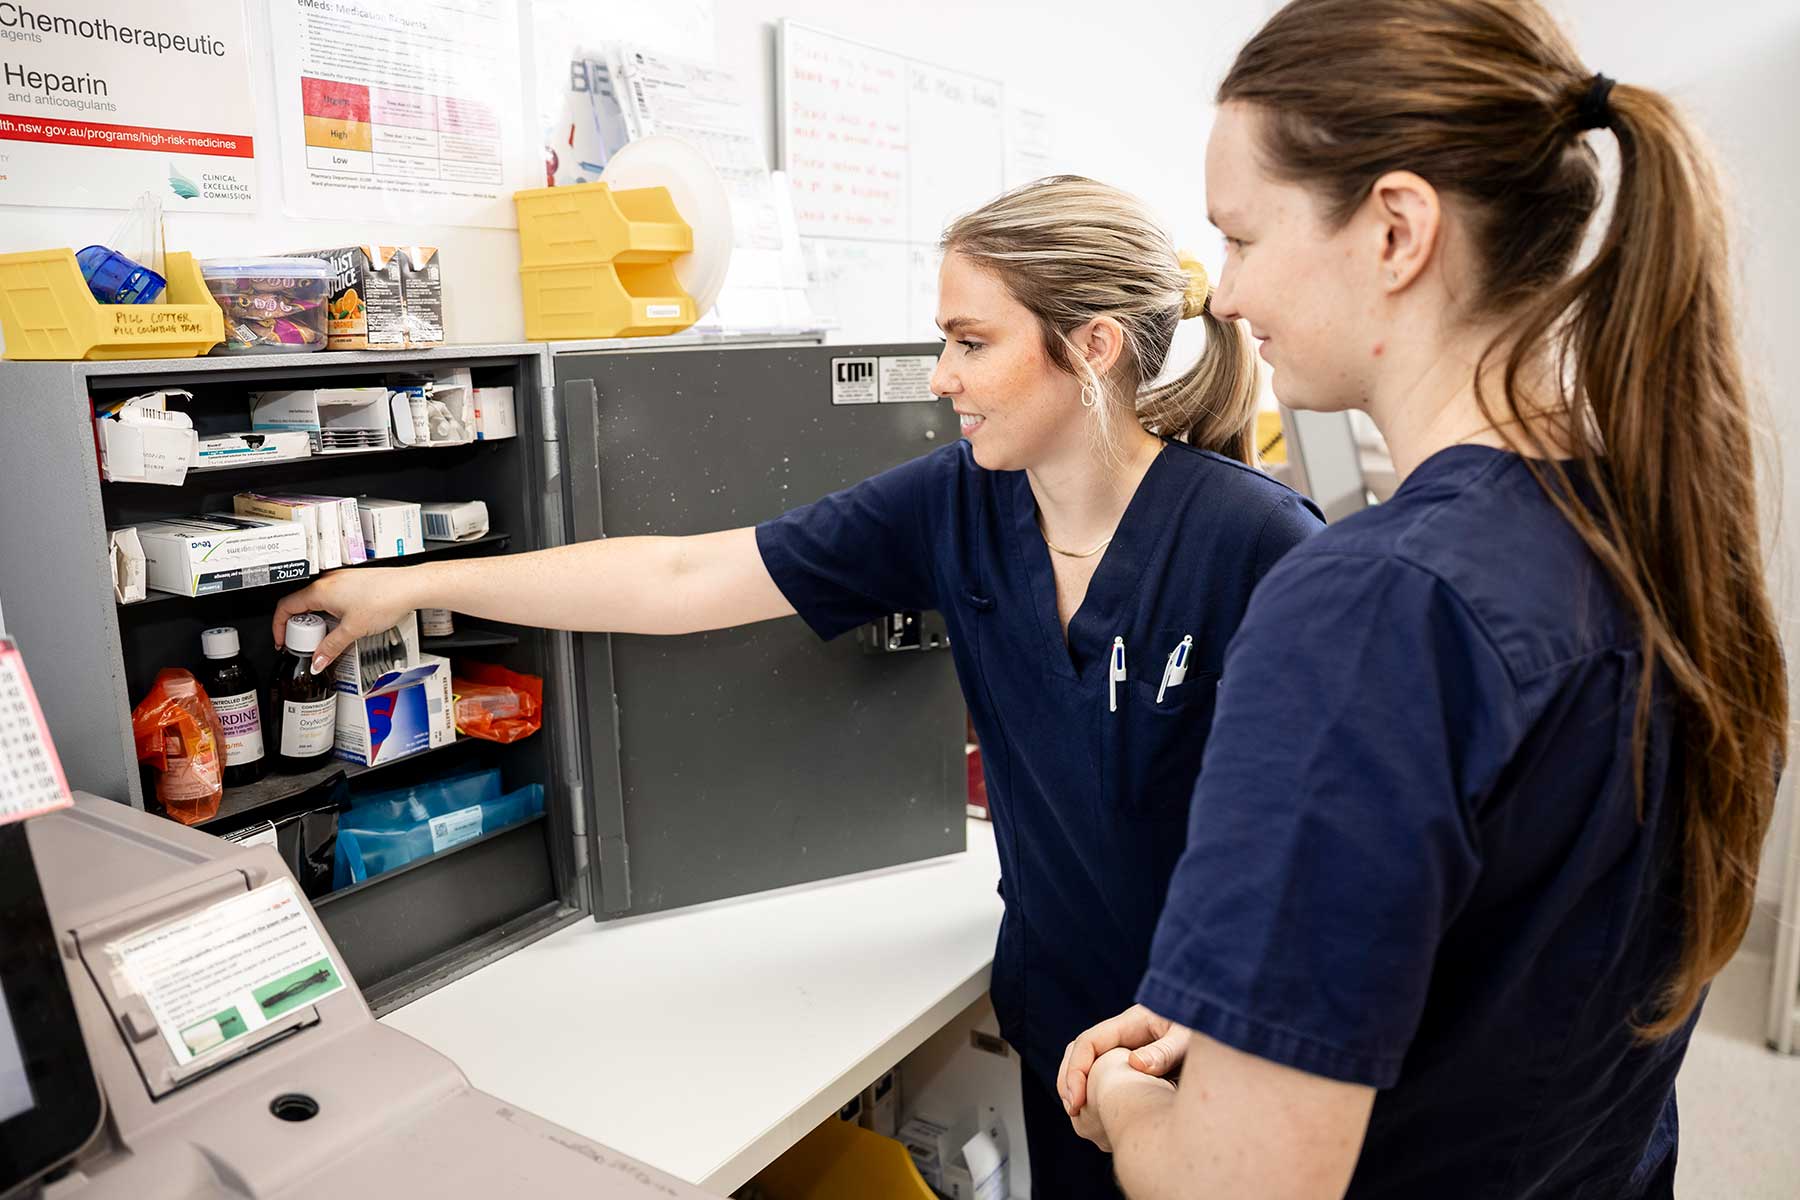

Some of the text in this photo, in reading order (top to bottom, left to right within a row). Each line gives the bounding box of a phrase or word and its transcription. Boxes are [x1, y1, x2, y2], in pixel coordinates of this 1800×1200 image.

[0, 2, 225, 57] Chemotherapeutic
[1, 29, 42, 43] agents
[4, 62, 108, 96] Heparin
[8, 92, 117, 112] and anticoagulants
[330, 127, 349, 141] High
[332, 155, 349, 165] Low
[202, 174, 237, 182] CLINICAL
[203, 183, 249, 191] EXCELLENCE
[203, 191, 252, 200] COMMISSION
[330, 251, 353, 274] JUST
[327, 268, 358, 298] JUICE
[116, 312, 143, 323] PILL
[114, 326, 135, 335] PILL
[191, 541, 211, 549] teva
[267, 542, 280, 550] 200
[210, 697, 240, 706] ONTROLLED
